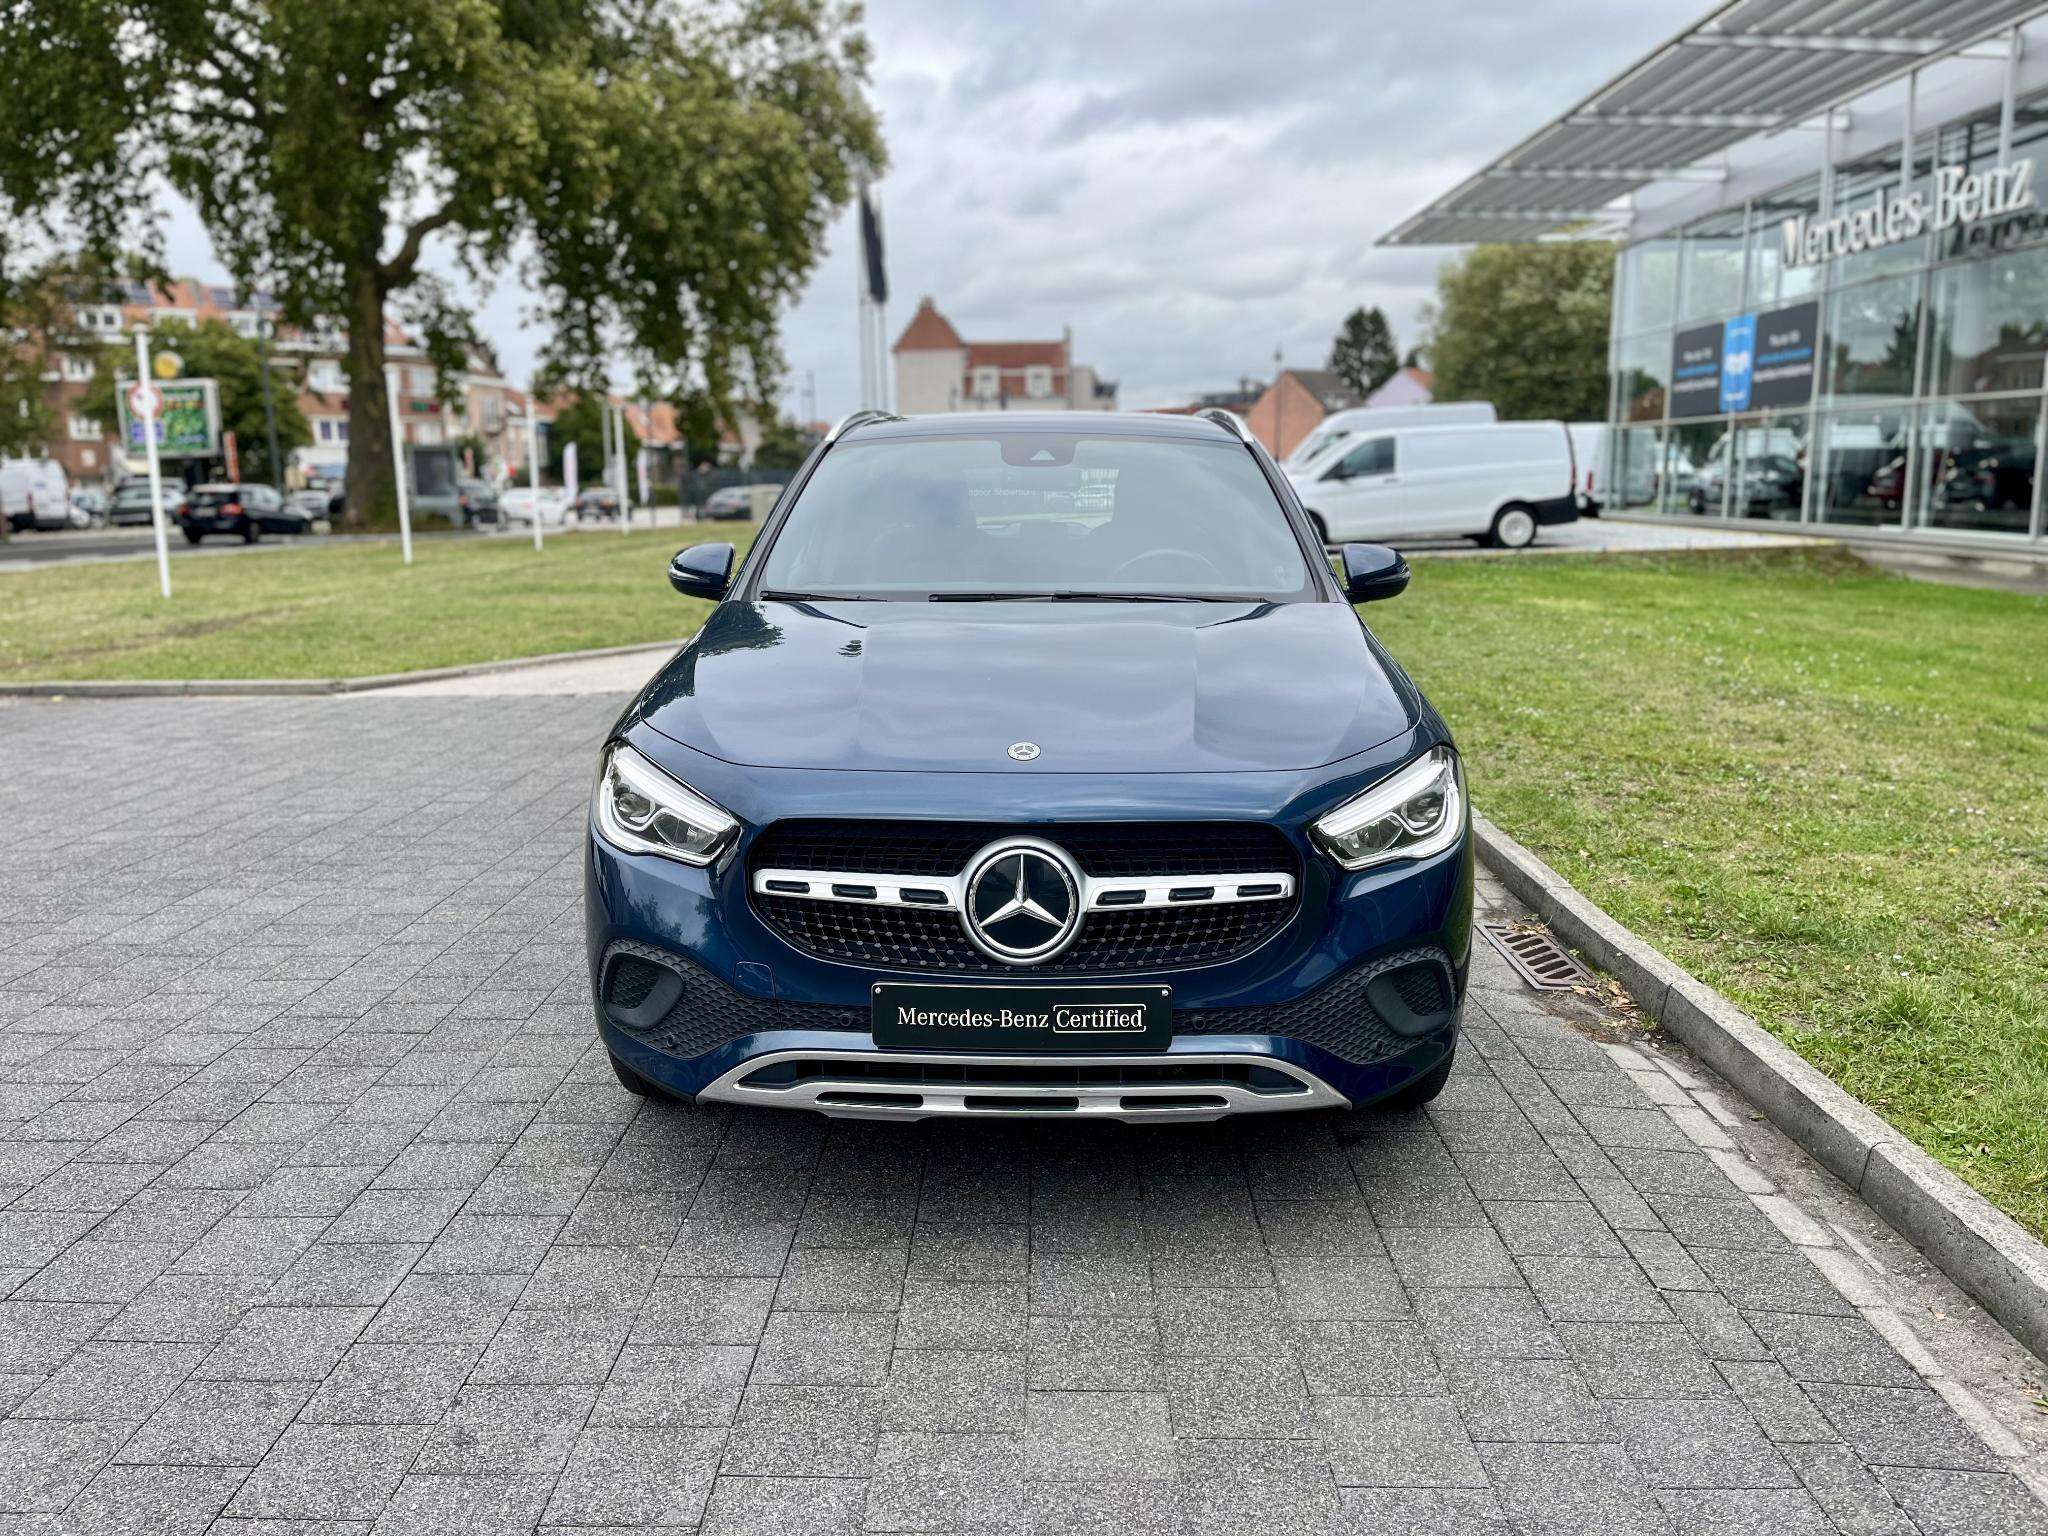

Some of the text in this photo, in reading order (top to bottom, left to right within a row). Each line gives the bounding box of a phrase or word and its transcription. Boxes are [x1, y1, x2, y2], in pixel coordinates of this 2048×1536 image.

[1782, 159, 2034, 268] Mercedes-Benz
[897, 1007, 1143, 1029] Mercedes-Benz Certified
